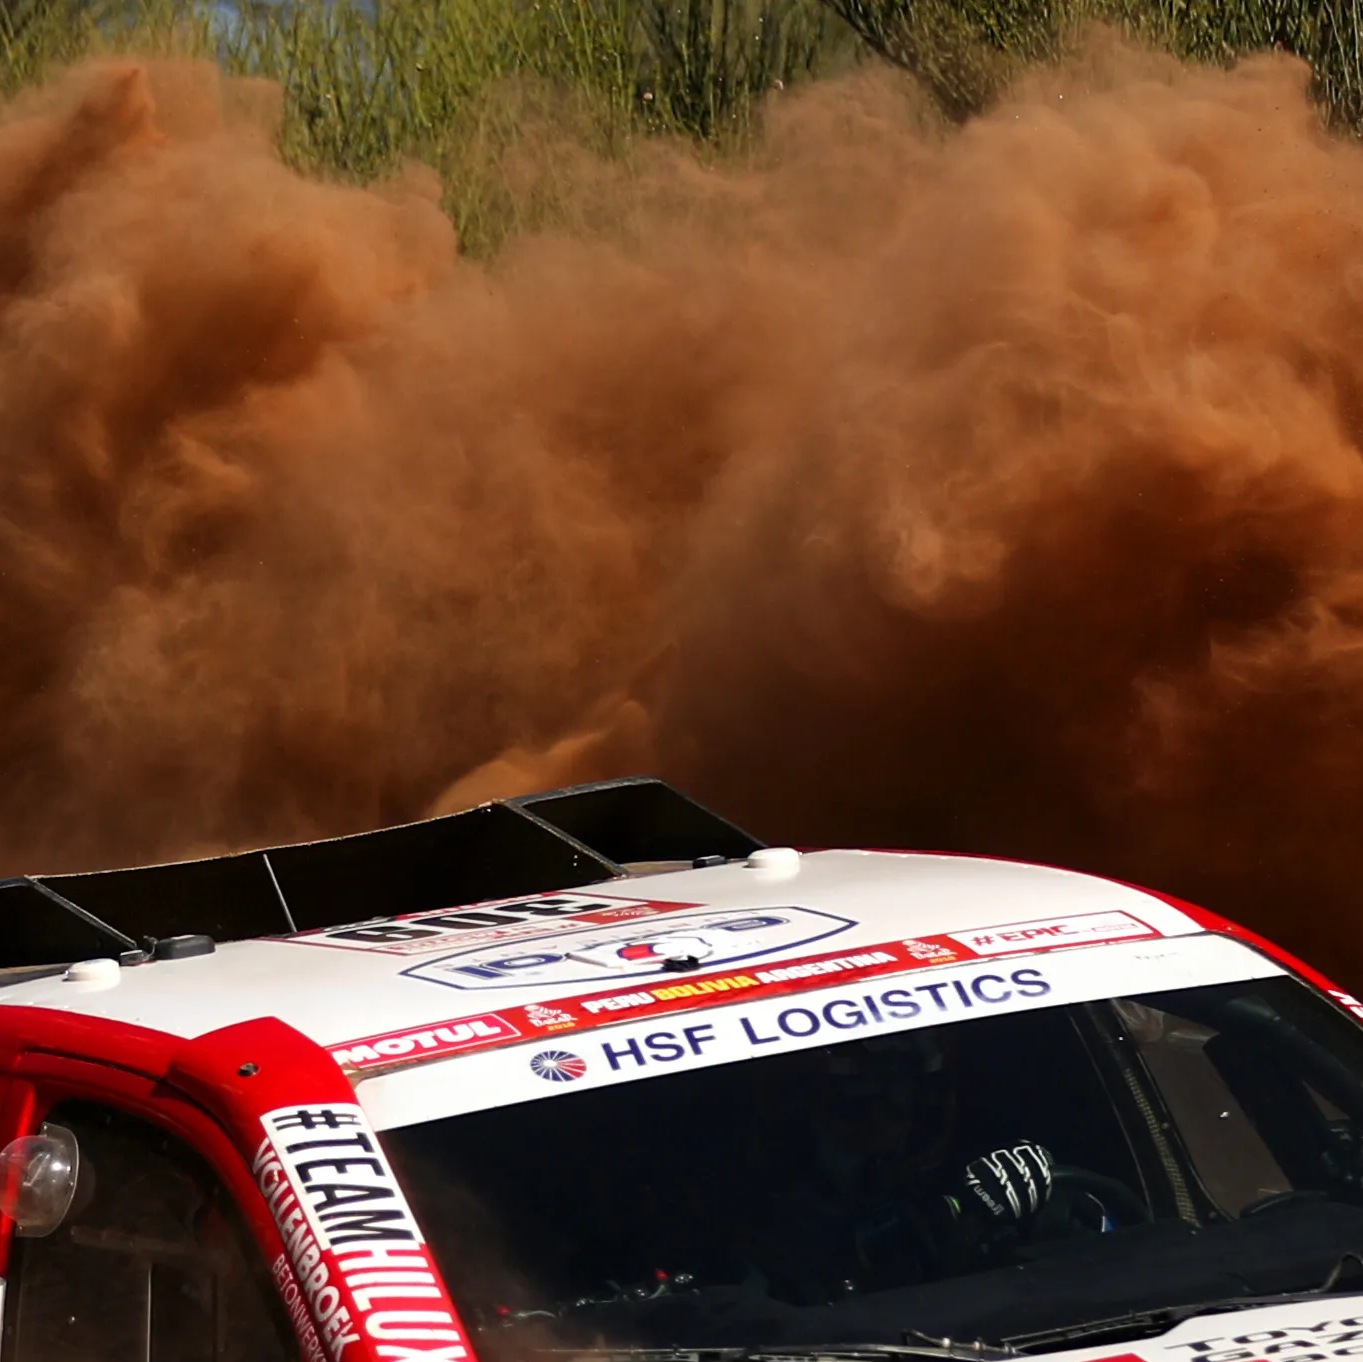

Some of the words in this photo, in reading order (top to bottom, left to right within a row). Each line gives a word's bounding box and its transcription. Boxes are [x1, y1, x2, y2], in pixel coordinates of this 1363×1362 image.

[971, 924, 1079, 947] #EPIC
[581, 991, 655, 1014] PERU
[652, 975, 759, 1001] BOLIVIA
[754, 951, 898, 984] ARGENTINA
[332, 1020, 502, 1066] MOTUL
[601, 1024, 716, 1071] HSF
[740, 968, 1051, 1046] LOGISTICS
